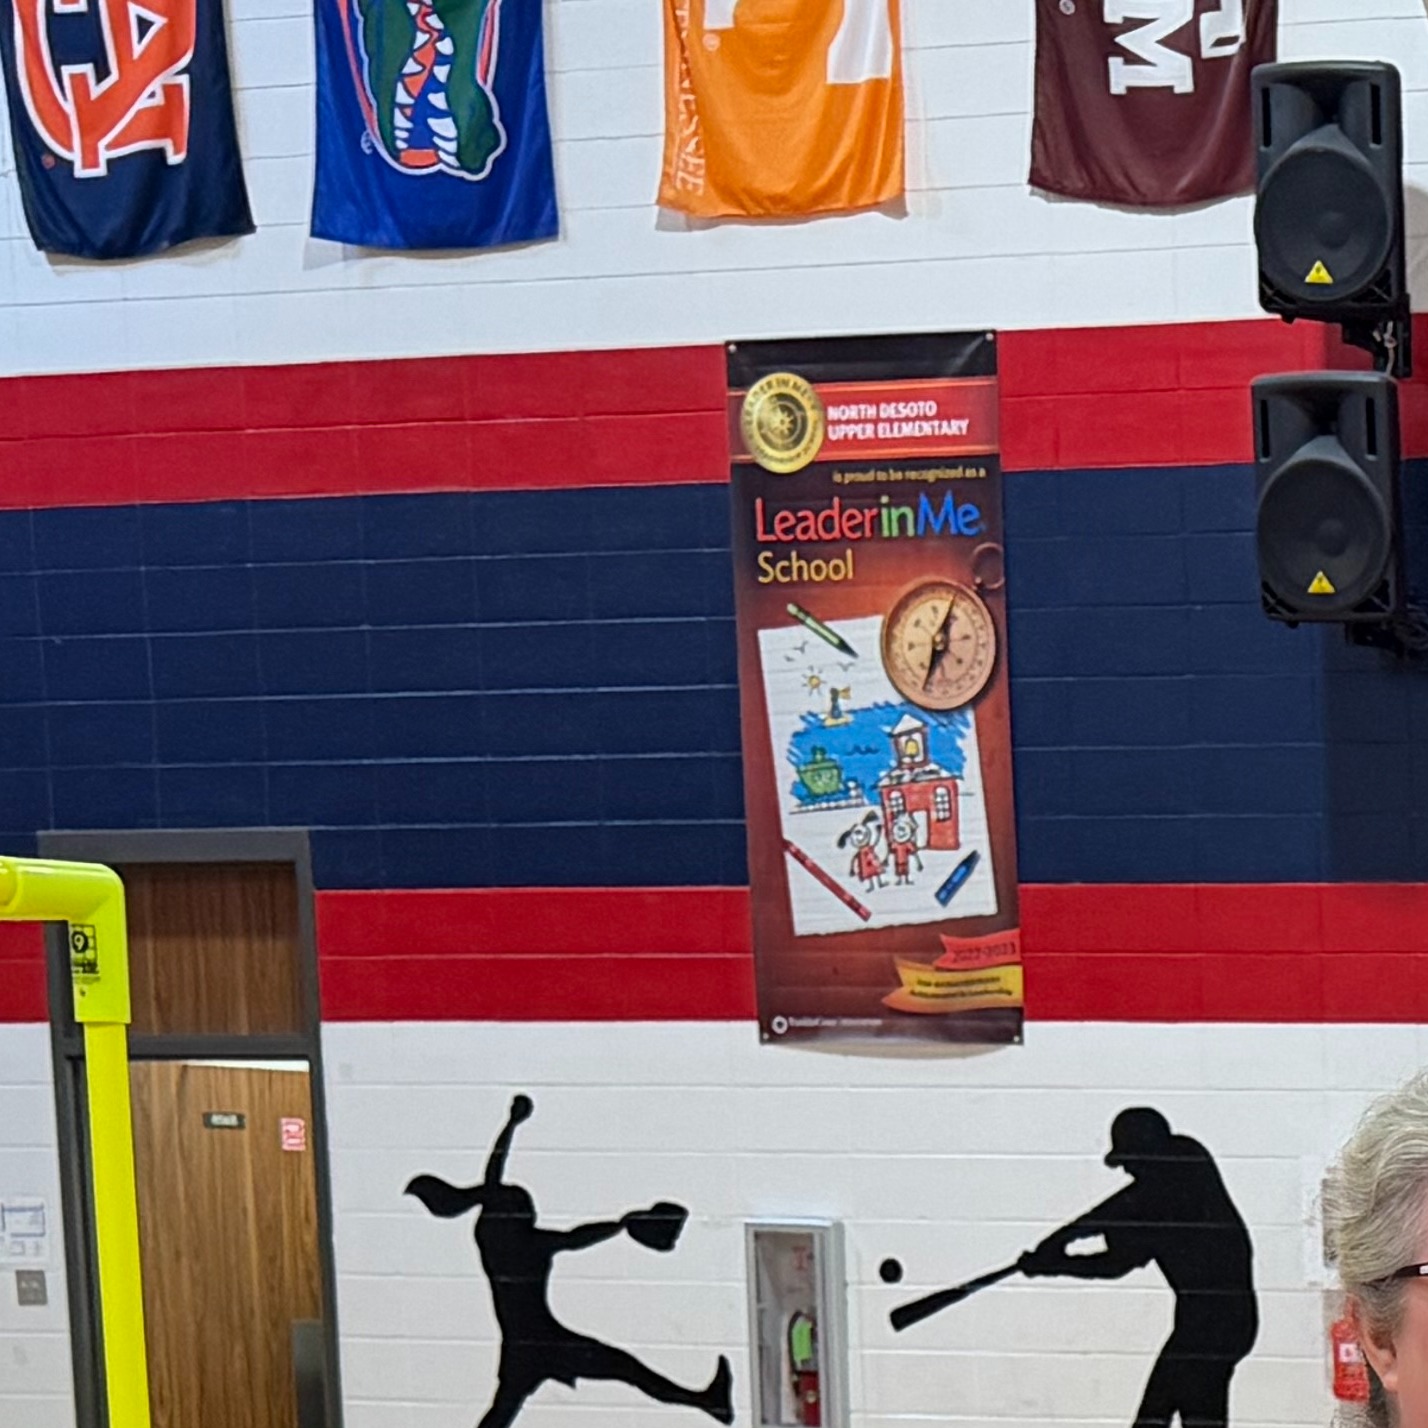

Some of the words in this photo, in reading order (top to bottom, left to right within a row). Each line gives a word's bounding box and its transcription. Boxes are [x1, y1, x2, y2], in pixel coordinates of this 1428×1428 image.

[827, 403, 877, 421] NORTH
[879, 400, 938, 419] DESOTO
[827, 423, 875, 441] UPPER
[877, 418, 969, 439] ELEMENTARY
[757, 548, 854, 584] School
